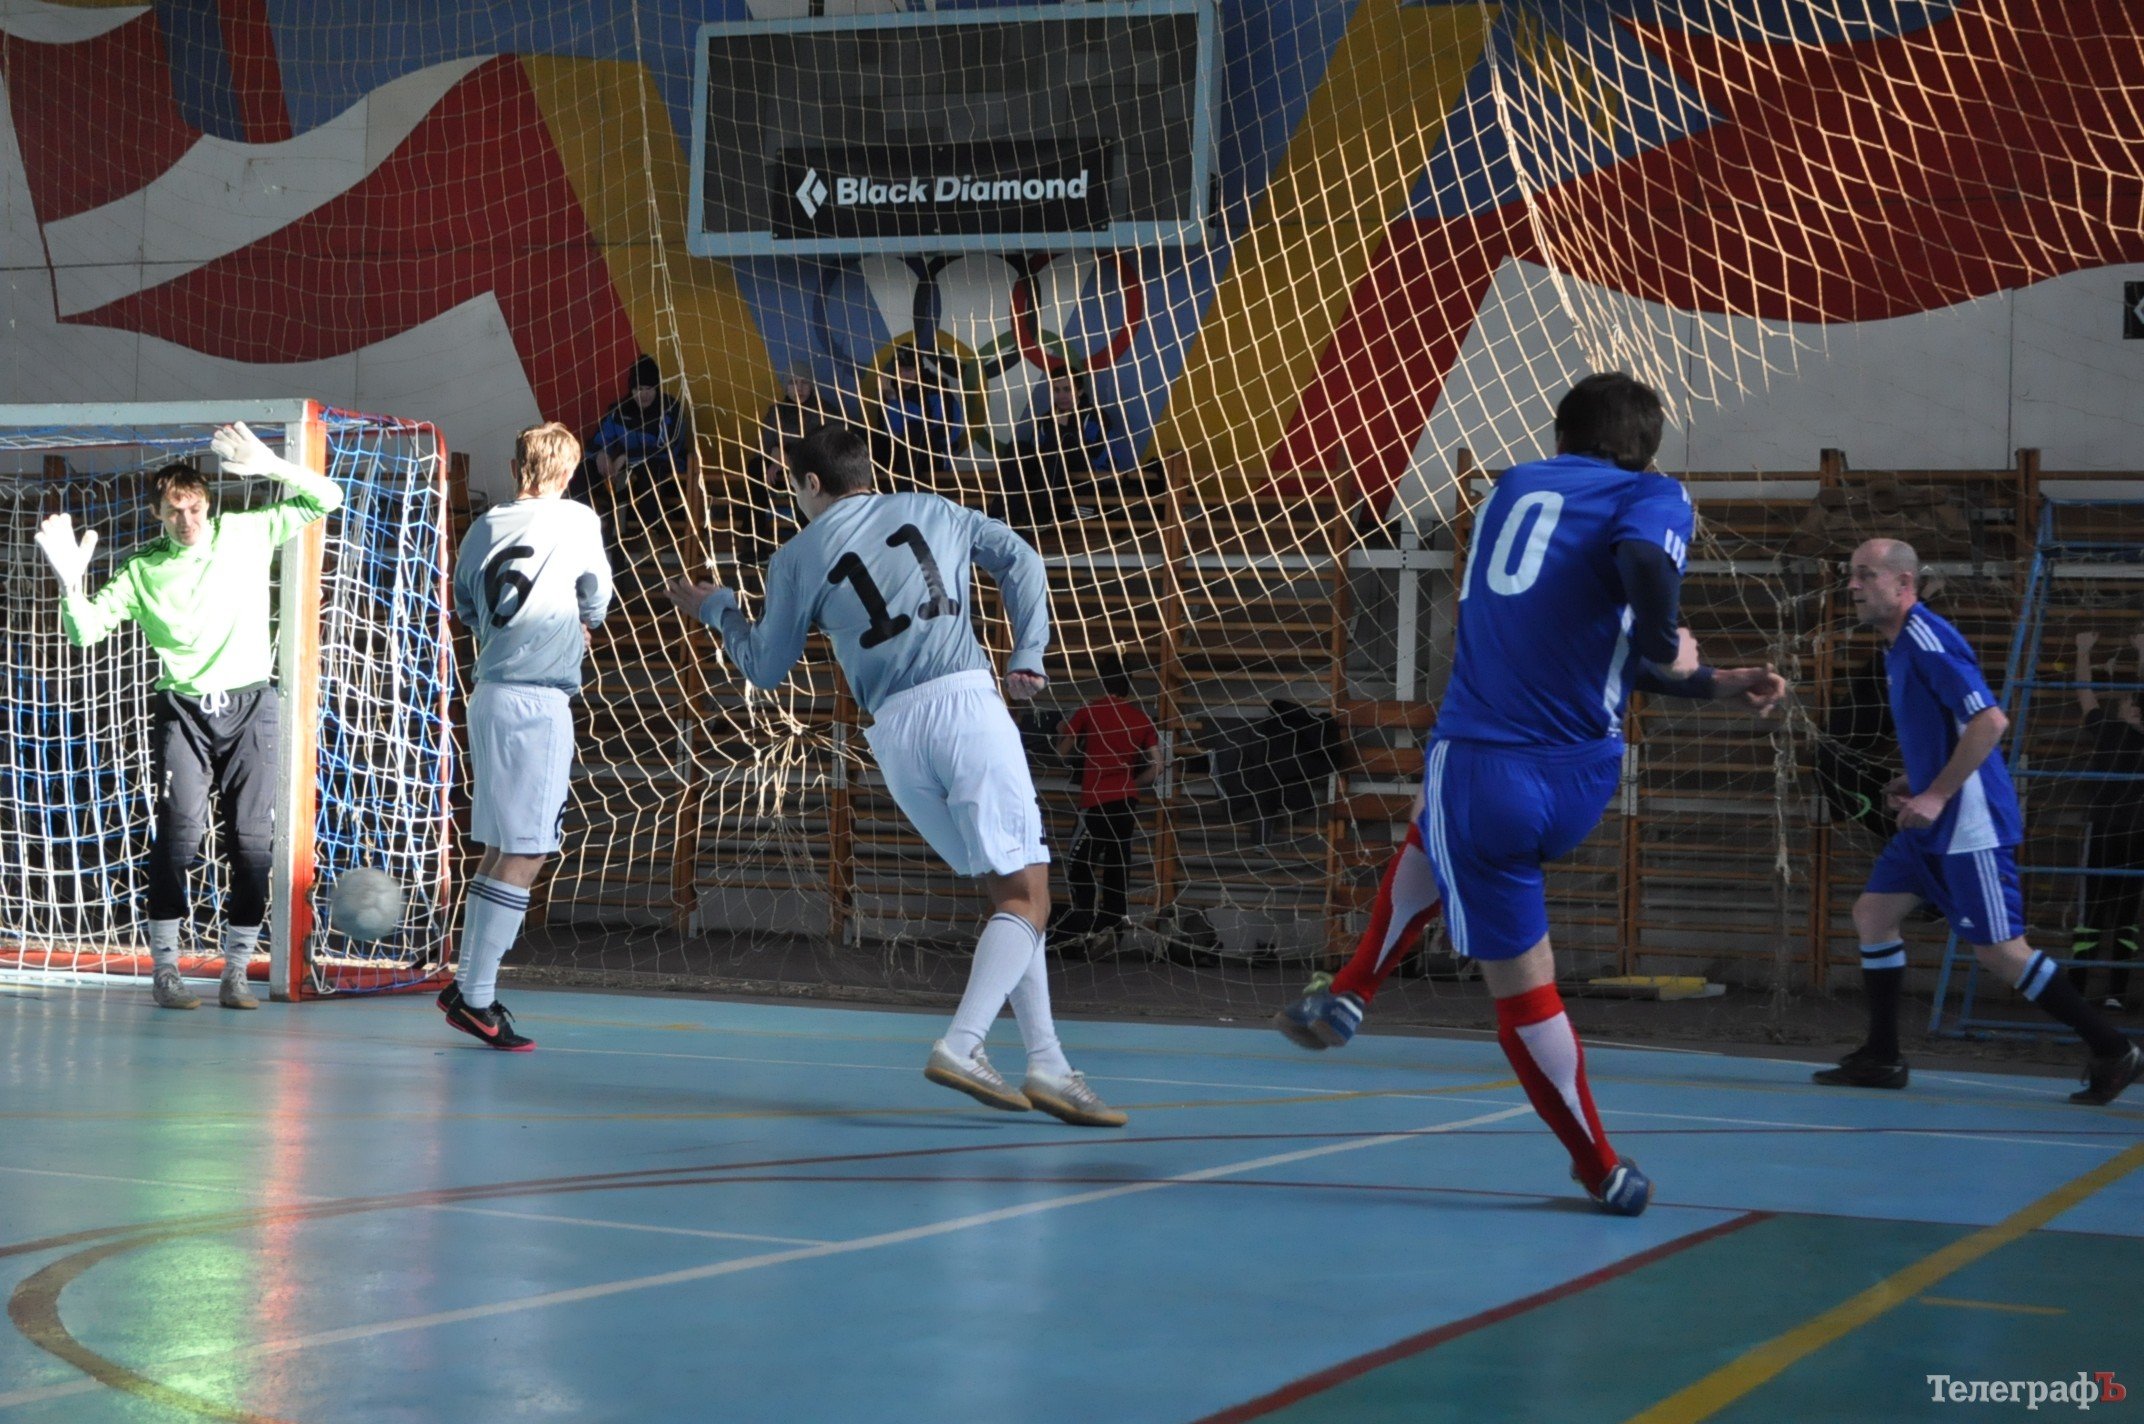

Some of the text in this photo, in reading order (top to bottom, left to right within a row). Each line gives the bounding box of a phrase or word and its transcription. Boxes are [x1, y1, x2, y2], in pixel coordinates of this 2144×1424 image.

[836, 169, 1089, 205] Black Diamond
[484, 545, 535, 629] 6
[827, 523, 960, 649] 11
